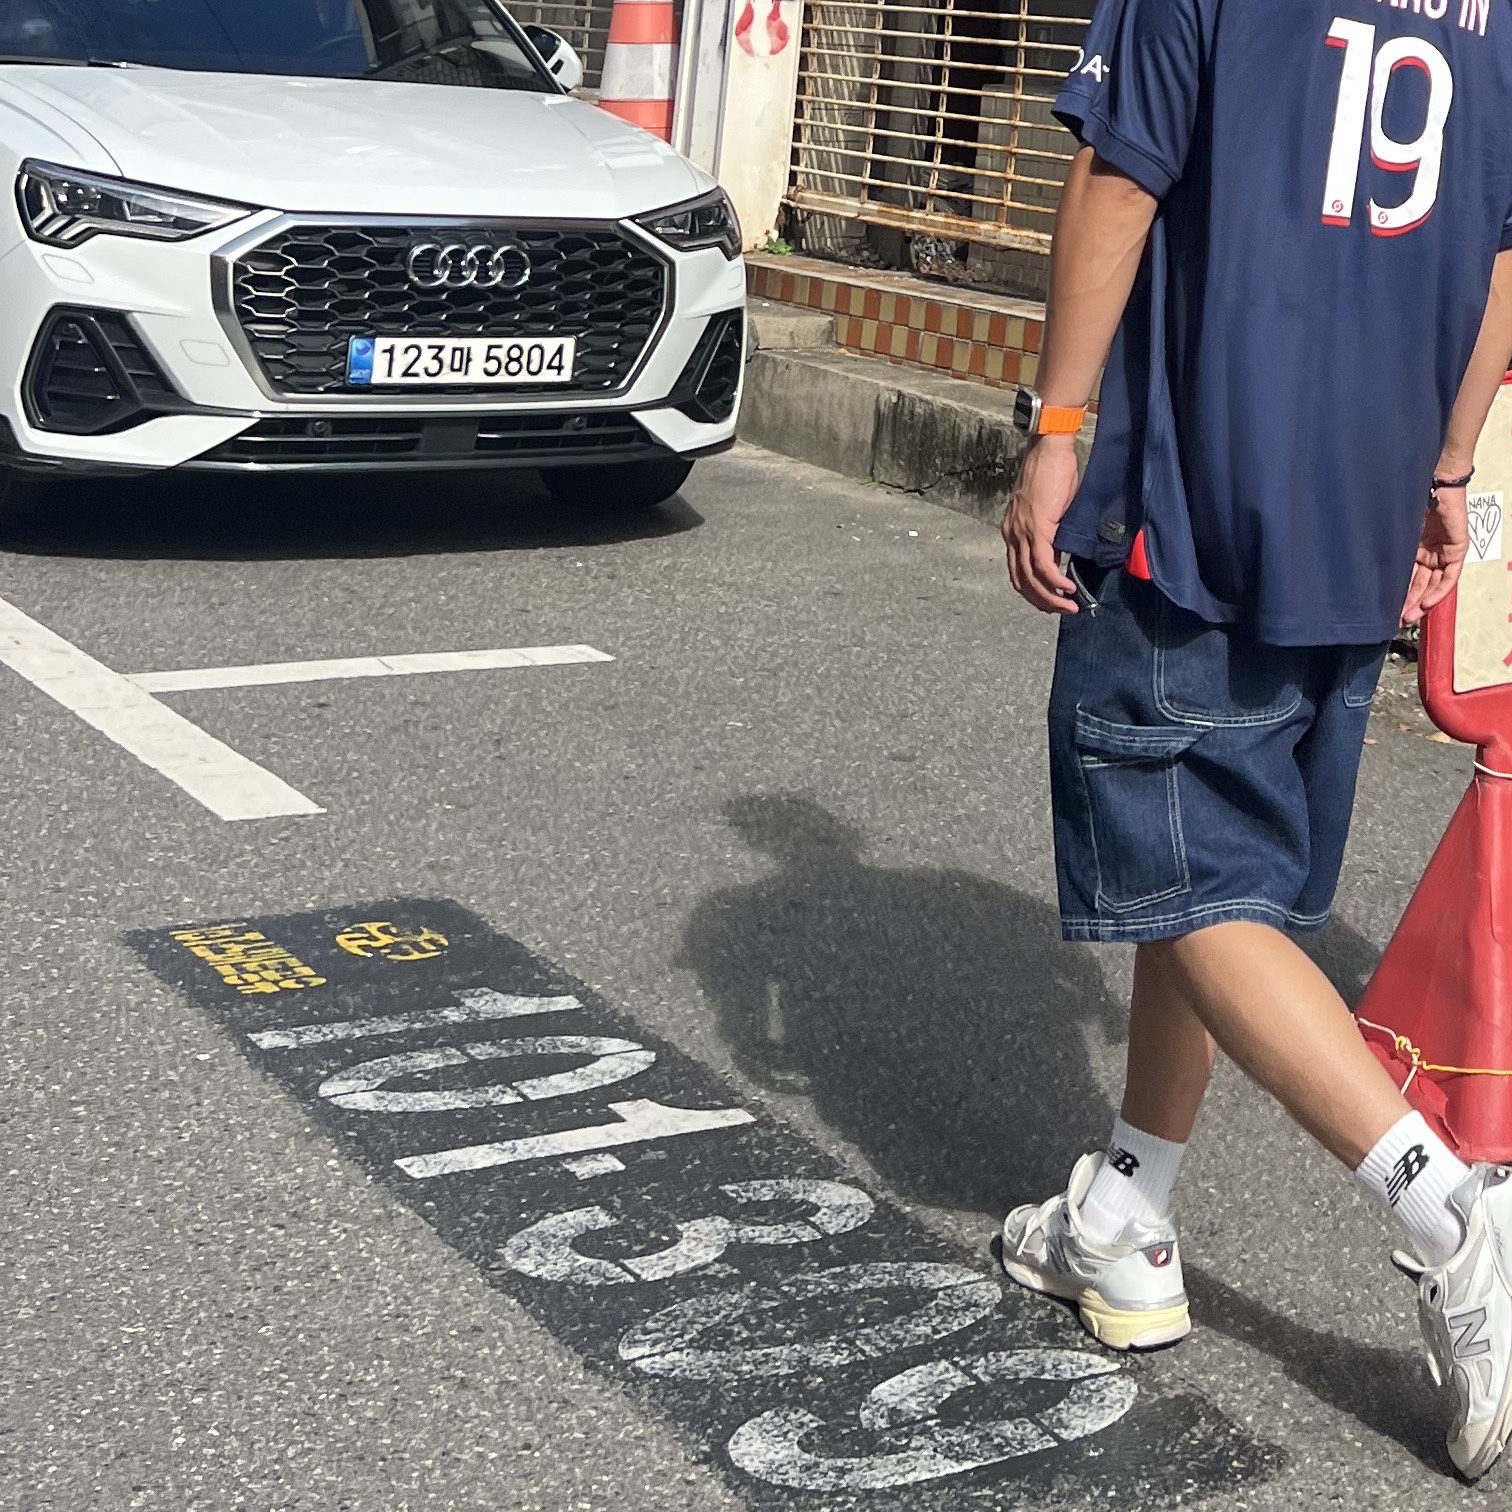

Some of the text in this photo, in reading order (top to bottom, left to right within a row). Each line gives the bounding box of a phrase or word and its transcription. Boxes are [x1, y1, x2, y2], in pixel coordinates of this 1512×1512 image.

[1321, 16, 1453, 237] 19
[381, 344, 472, 378] 123마
[483, 343, 565, 377] 5804
